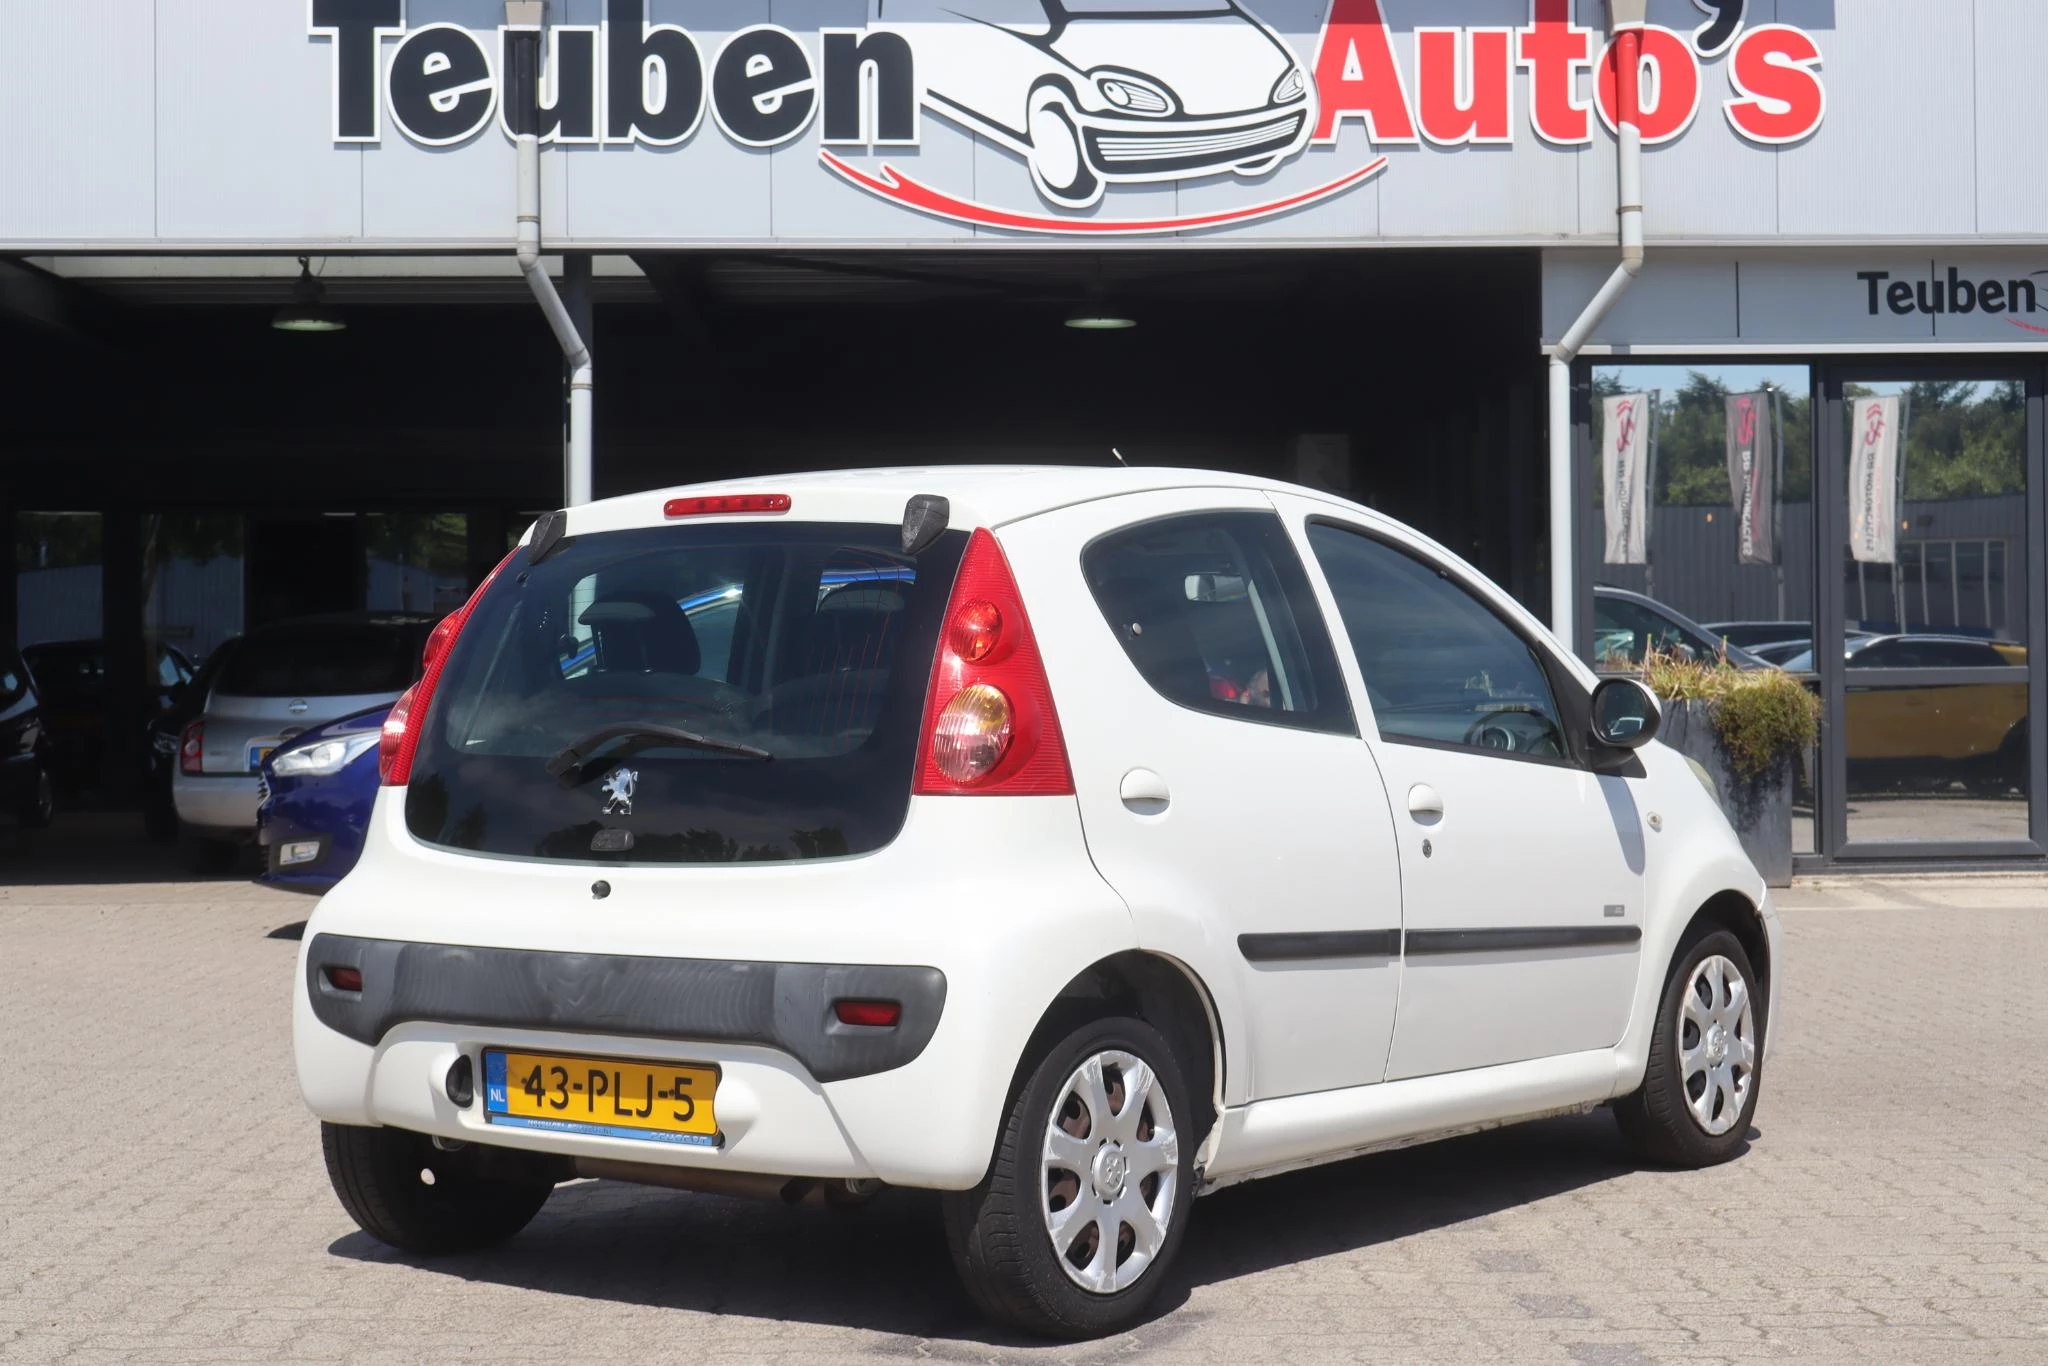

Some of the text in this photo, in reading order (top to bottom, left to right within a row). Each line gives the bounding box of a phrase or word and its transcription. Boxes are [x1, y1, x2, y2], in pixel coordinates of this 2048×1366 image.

[308, 0, 1827, 146] Teuben Auto's
[1857, 267, 2036, 315] Teuben
[490, 1088, 505, 1103] NL
[524, 1065, 695, 1122] 43-PLJ-5
